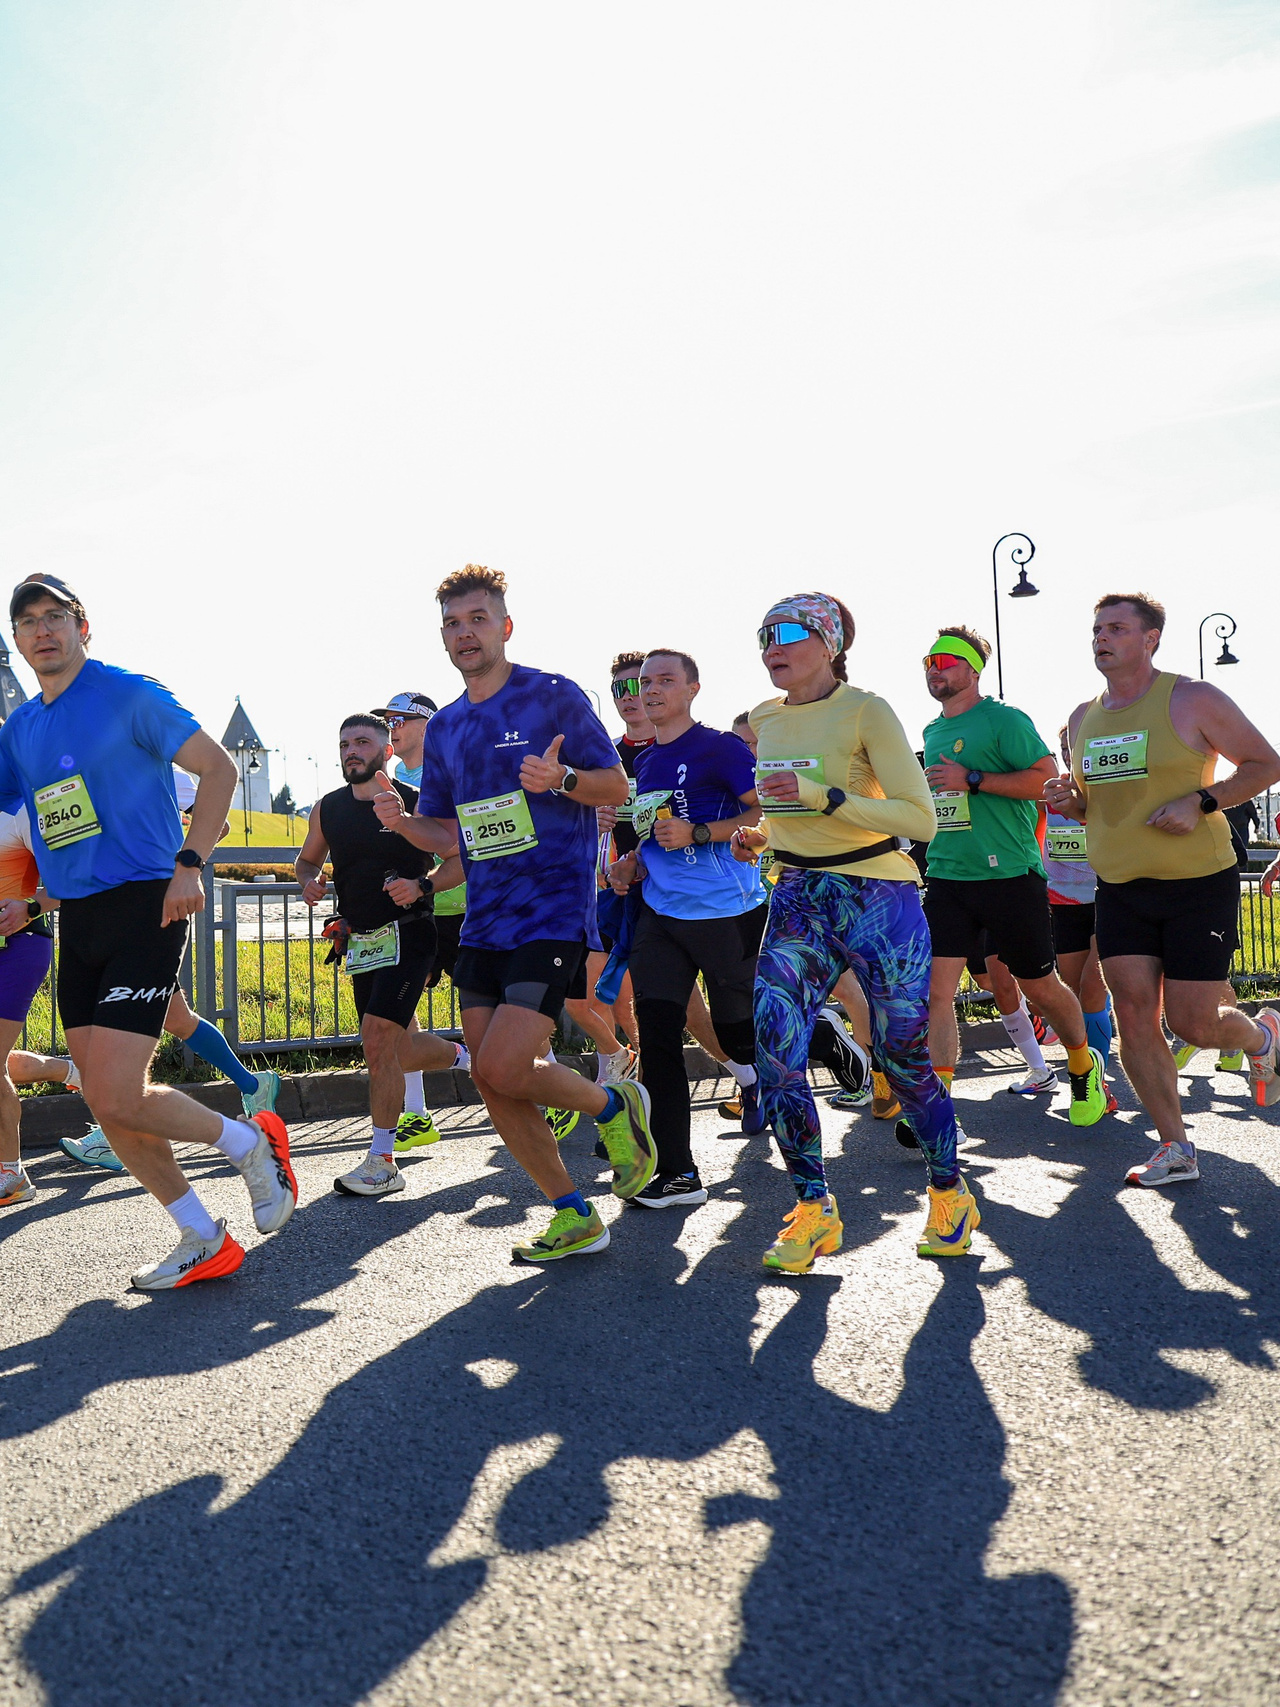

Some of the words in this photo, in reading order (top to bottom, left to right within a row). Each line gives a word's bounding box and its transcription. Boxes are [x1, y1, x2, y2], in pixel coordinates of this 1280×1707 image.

[1084, 760, 1090, 769] B
[1099, 752, 1129, 767] 836
[39, 818, 45, 830] B
[45, 804, 82, 828] 2540
[465, 830, 473, 842] B
[477, 819, 517, 839] 2515
[1056, 841, 1080, 850] 770
